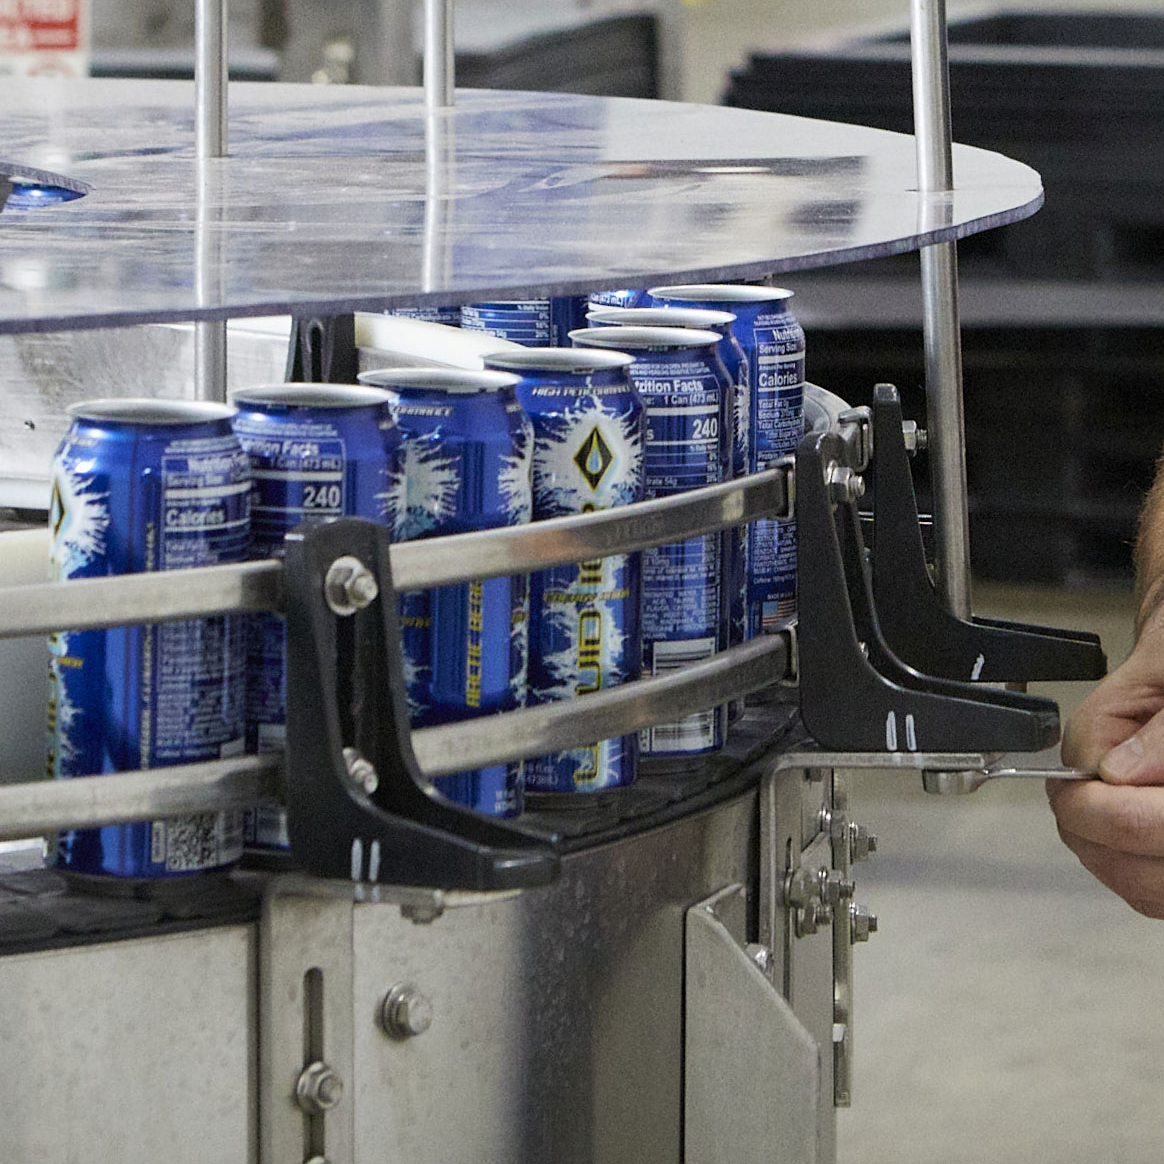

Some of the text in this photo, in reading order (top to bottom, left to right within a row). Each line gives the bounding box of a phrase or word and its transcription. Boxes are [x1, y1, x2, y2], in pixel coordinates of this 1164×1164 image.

[758, 343, 786, 356] Serving
[673, 379, 703, 393] Facts
[758, 370, 798, 387] Calories
[532, 387, 561, 397] HIGH
[664, 395, 669, 405] 1
[671, 394, 689, 405] Can
[689, 392, 705, 406] (473
[692, 418, 718, 440] 240
[303, 486, 341, 508] 240
[166, 508, 226, 526] Calories
[573, 608, 602, 783] LUID
